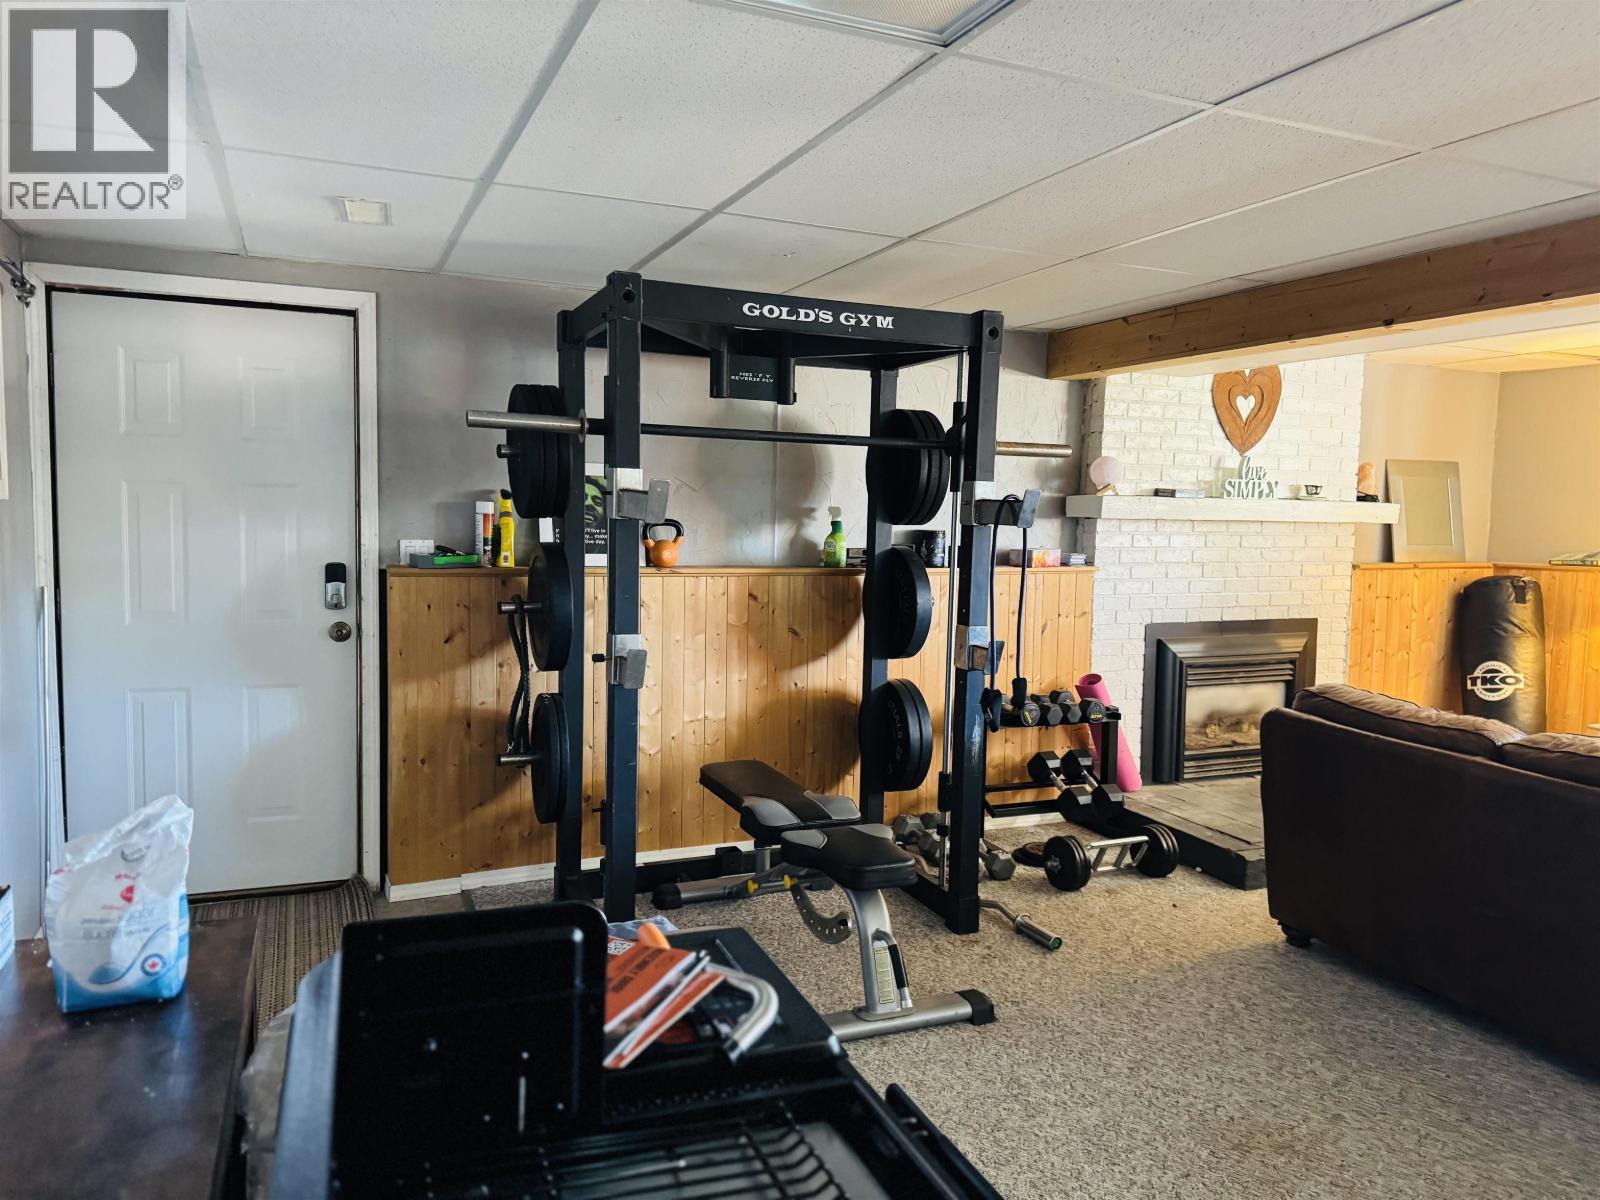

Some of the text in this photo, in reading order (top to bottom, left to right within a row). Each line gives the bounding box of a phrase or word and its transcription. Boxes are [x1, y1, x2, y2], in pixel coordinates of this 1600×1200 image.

[742, 302, 894, 329] GOLD'S GYM
[1224, 480, 1279, 499] SIMPLY
[1468, 675, 1522, 688] TKO
